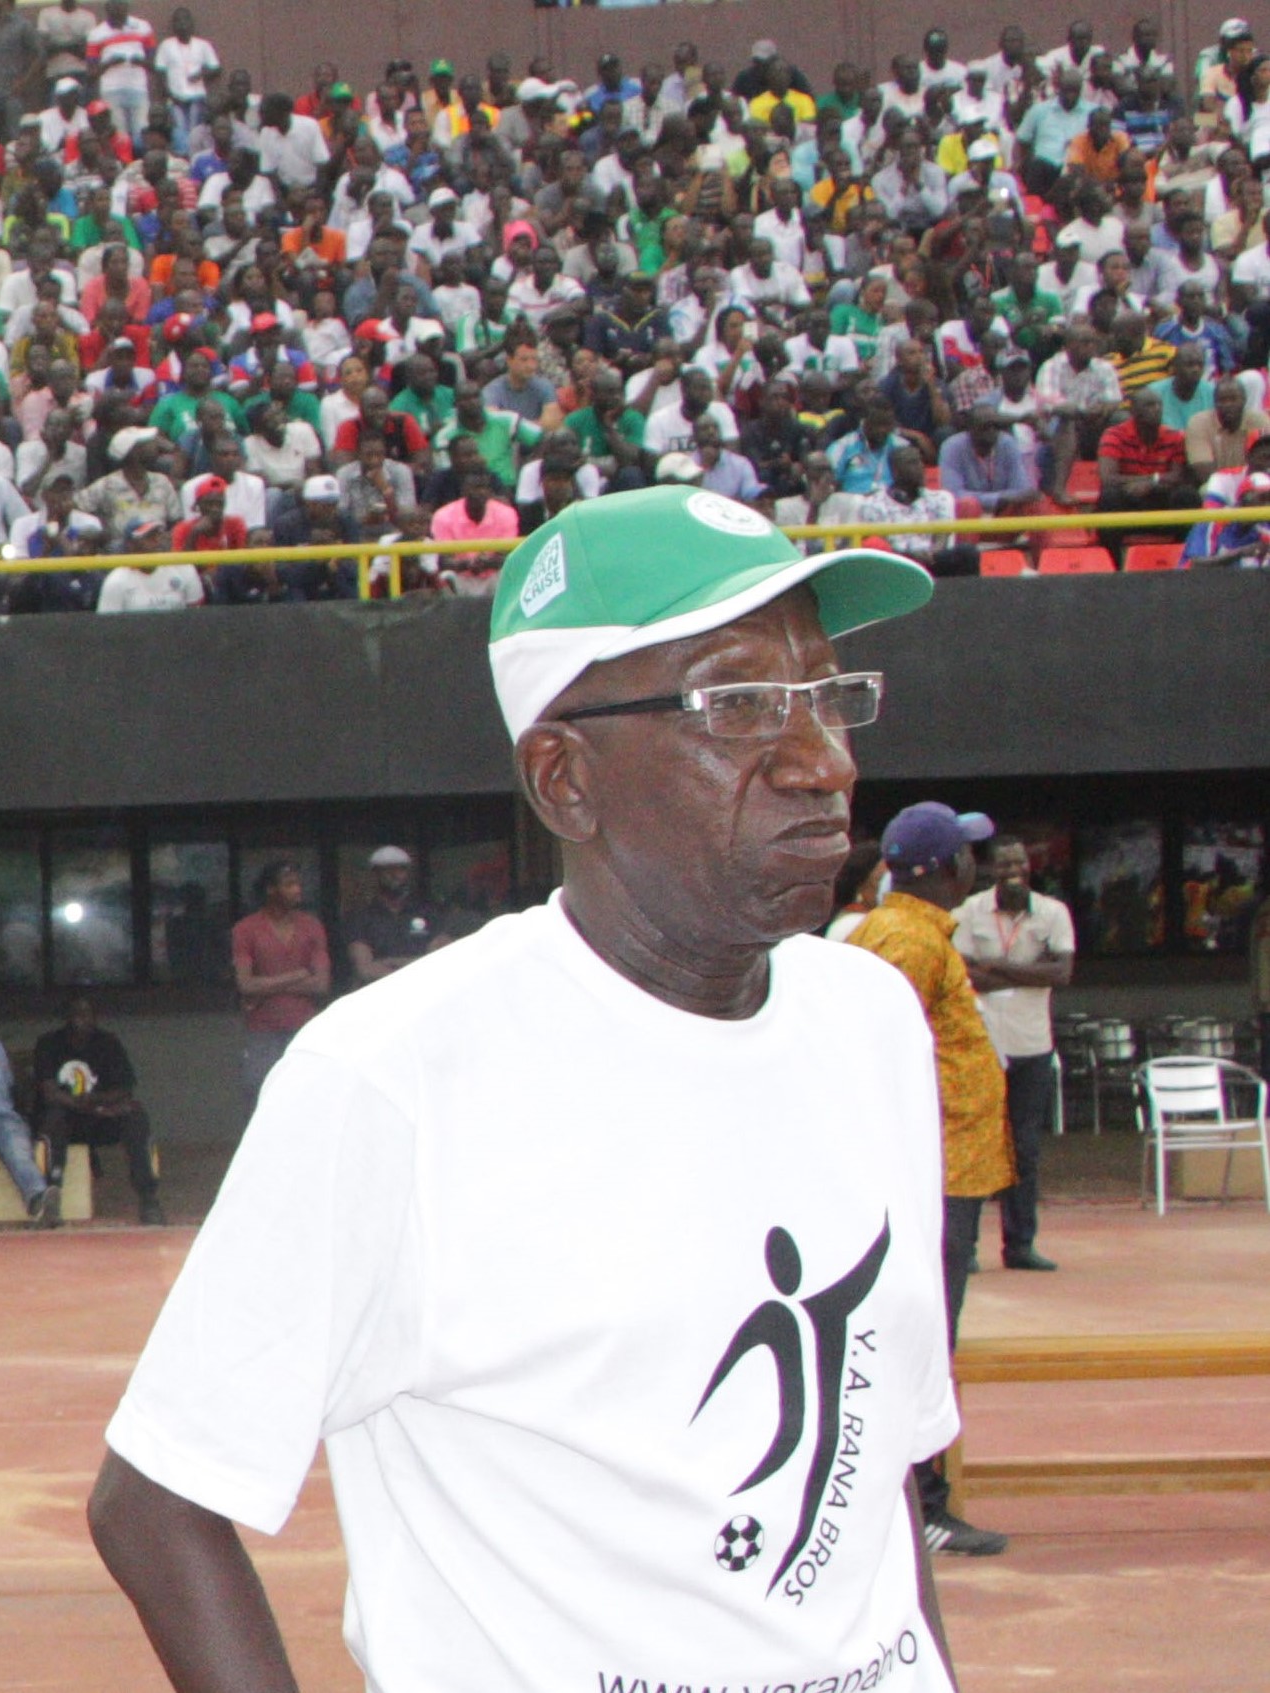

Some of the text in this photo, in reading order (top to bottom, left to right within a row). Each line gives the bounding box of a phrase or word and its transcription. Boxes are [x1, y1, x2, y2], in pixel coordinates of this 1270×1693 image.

[785, 1329, 877, 1606] Y. A. RANA BROS
